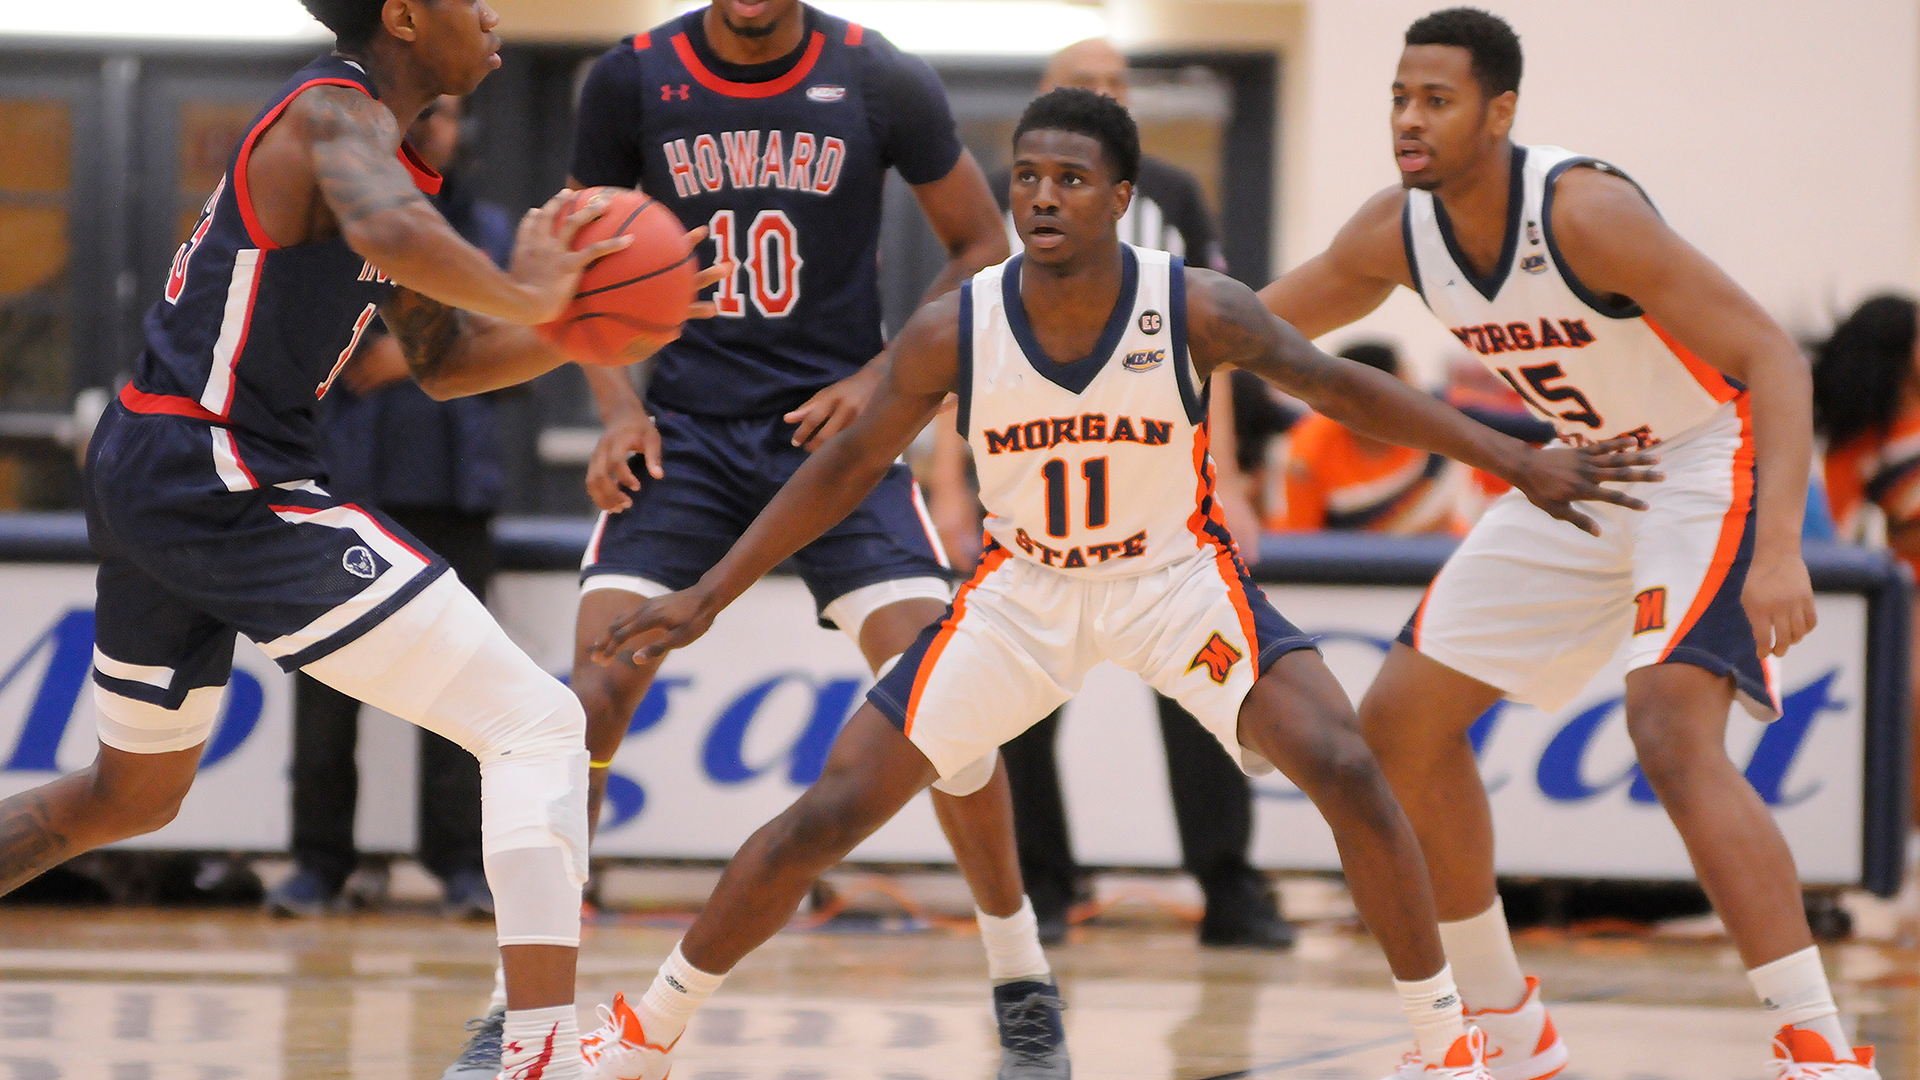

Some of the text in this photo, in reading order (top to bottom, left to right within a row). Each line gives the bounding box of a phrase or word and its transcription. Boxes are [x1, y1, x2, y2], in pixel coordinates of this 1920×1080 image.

[663, 130, 846, 198] HOWARD
[709, 210, 804, 318] 10
[1142, 315, 1160, 330] EC
[983, 412, 1174, 454] MORGAN
[1041, 455, 1109, 539] 11
[1016, 528, 1147, 568] STATE
